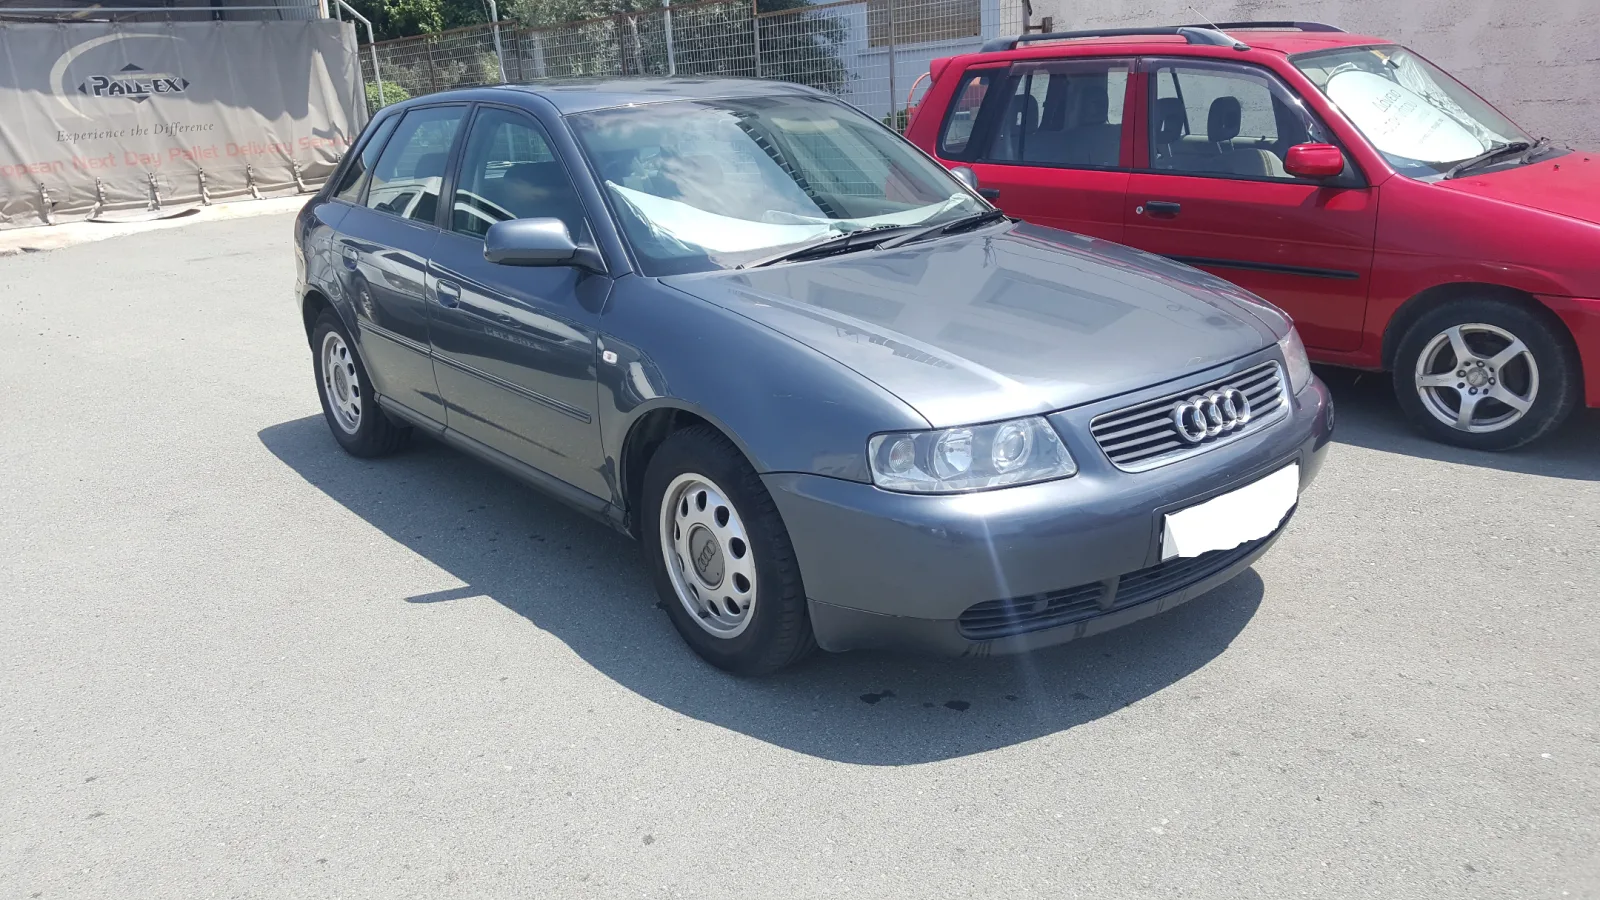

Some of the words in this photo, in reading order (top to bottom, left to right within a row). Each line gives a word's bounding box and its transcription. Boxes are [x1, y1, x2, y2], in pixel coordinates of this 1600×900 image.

[57, 129, 125, 144] Experience
[130, 124, 149, 137] the
[154, 122, 214, 137] Difference
[0, 160, 64, 178] opean
[72, 152, 116, 170] Next
[124, 151, 162, 168] Day
[169, 144, 218, 161] Pallet
[226, 141, 293, 158] Delivery
